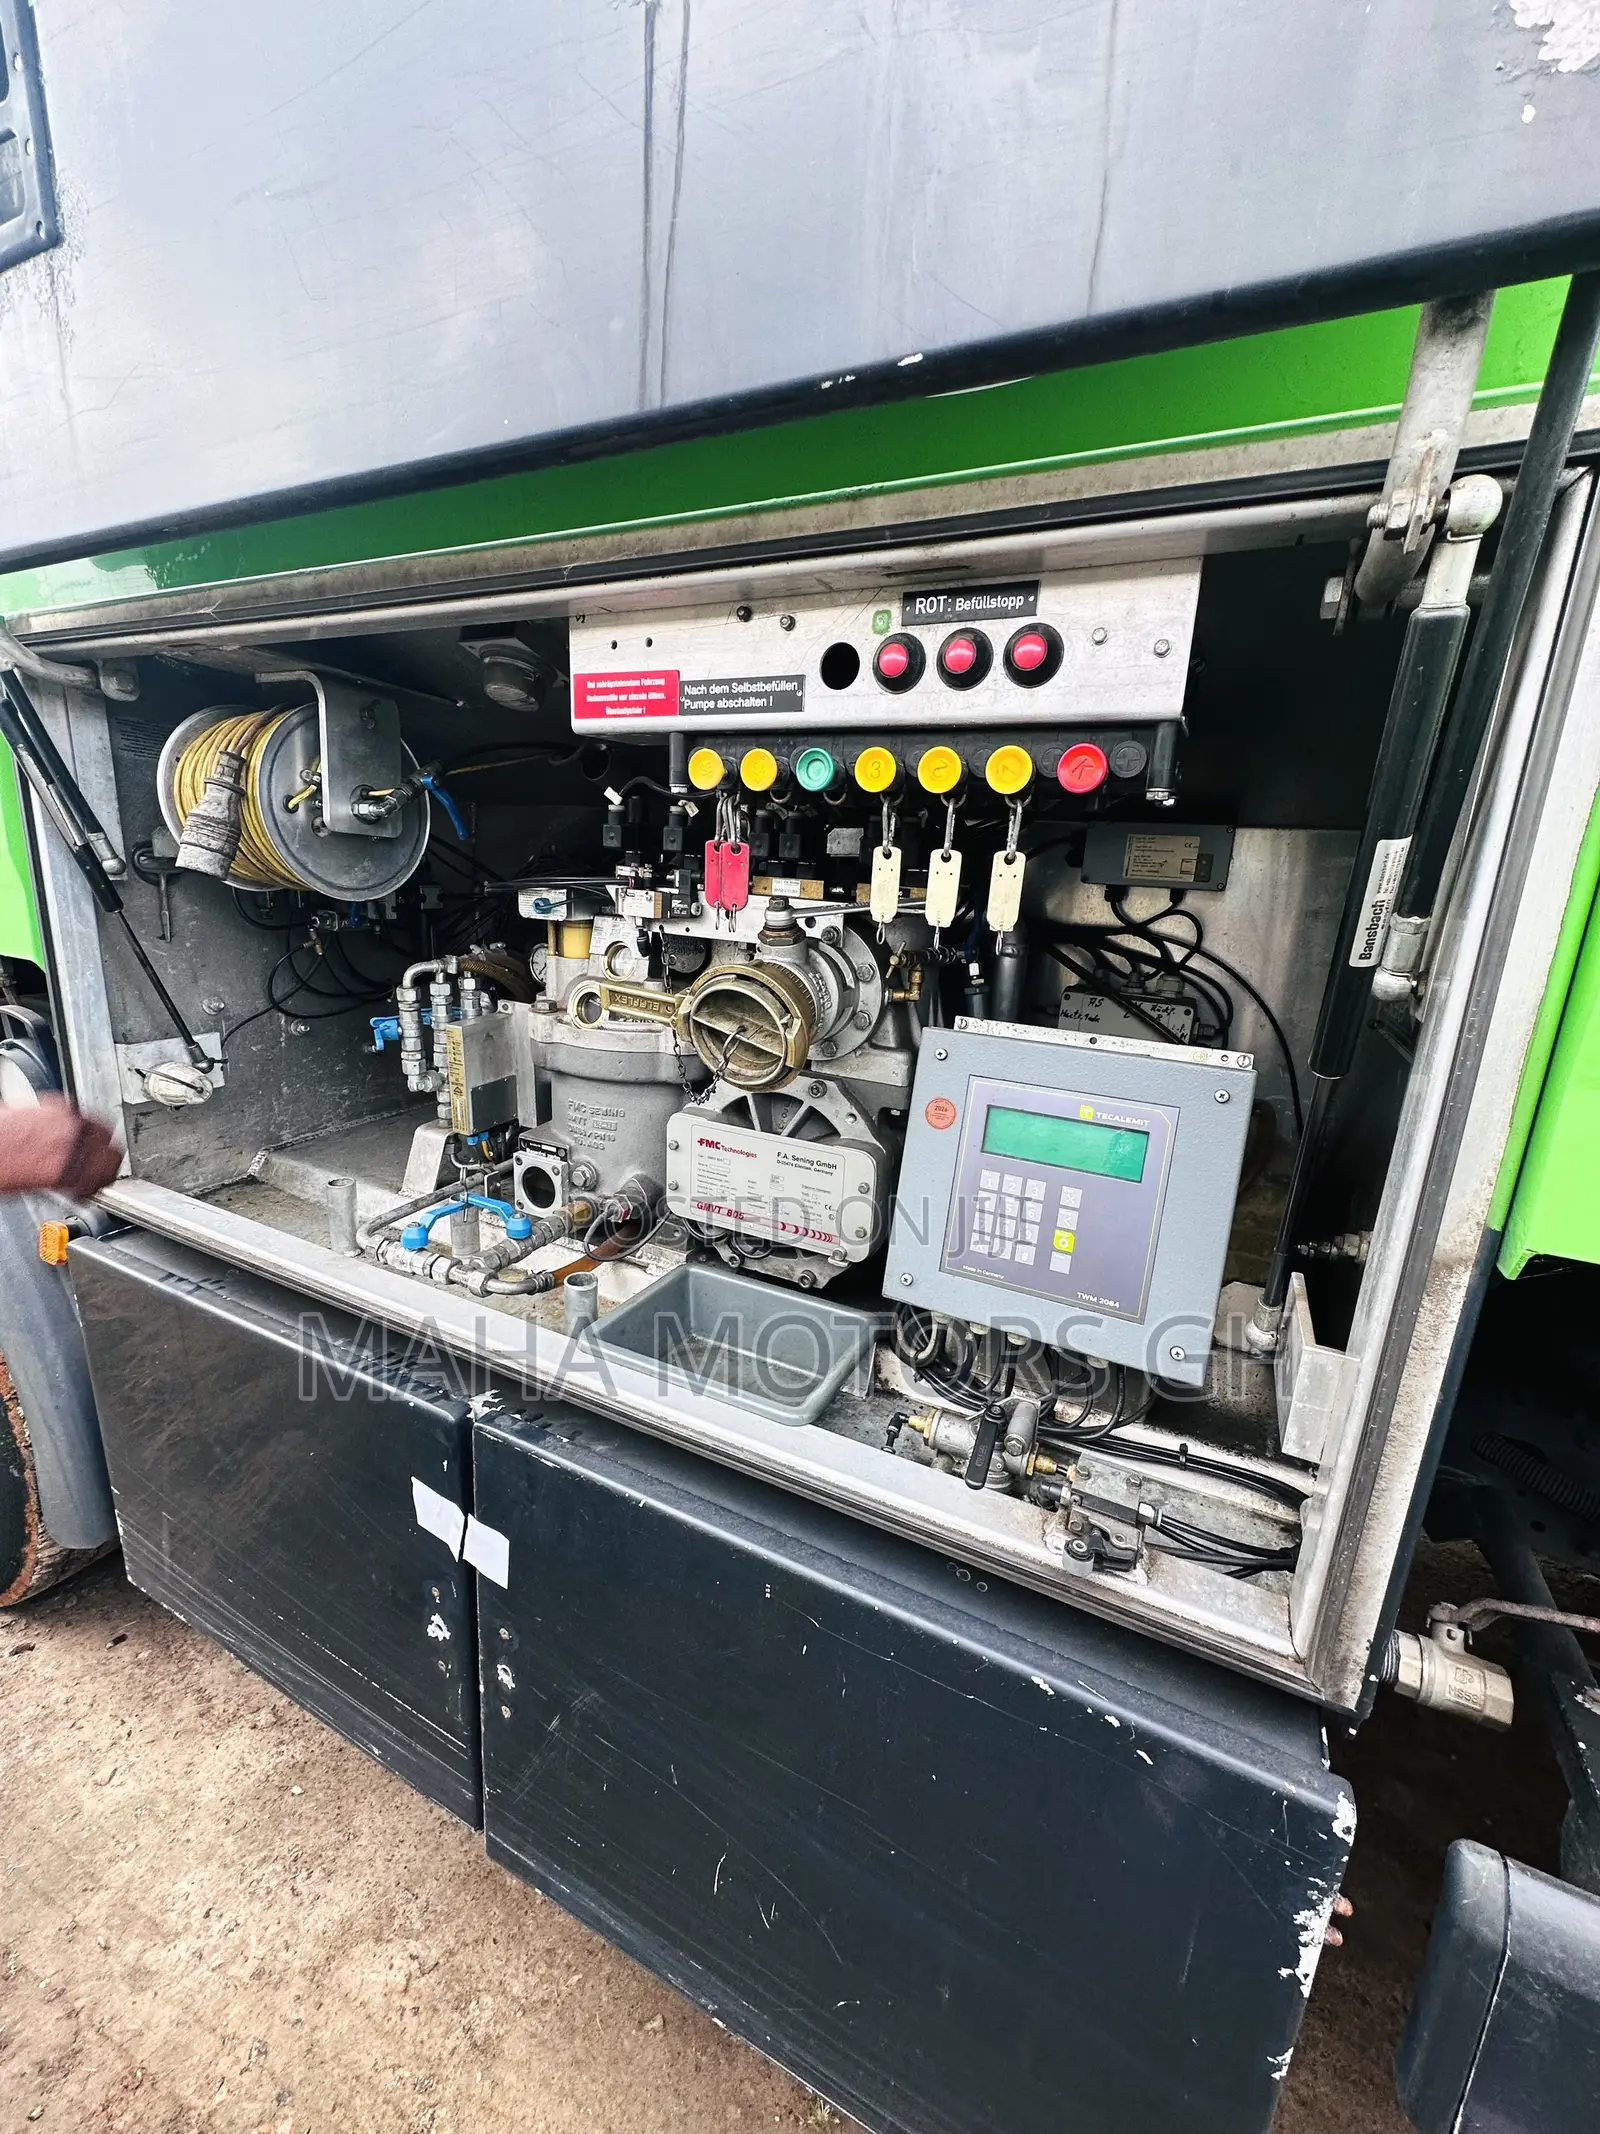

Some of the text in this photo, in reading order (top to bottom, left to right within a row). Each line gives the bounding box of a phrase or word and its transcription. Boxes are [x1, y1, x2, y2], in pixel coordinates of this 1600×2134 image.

[915, 595, 1024, 615] ROT: Befüllstopp
[684, 680, 798, 696] Nach dem Selbstbefüllen
[684, 698, 715, 711] Pumpe
[717, 696, 766, 708] abschalten
[870, 760, 881, 779] 3
[1072, 758, 1094, 780] K
[1358, 899, 1386, 961] Bansbach
[1096, 1112, 1151, 1126] TECALEMIT
[699, 1138, 757, 1159] FMC Technologies
[777, 1151, 838, 1171] F.A. Sening GmbH
[1009, 1182, 1016, 1192] 2
[1032, 1187, 1039, 1196] 3
[696, 1201, 745, 1221] GMVT 805
[1006, 1204, 1013, 1213] 5
[1027, 1209, 1035, 1218] 6
[1077, 1291, 1120, 1309] TWM 2084
